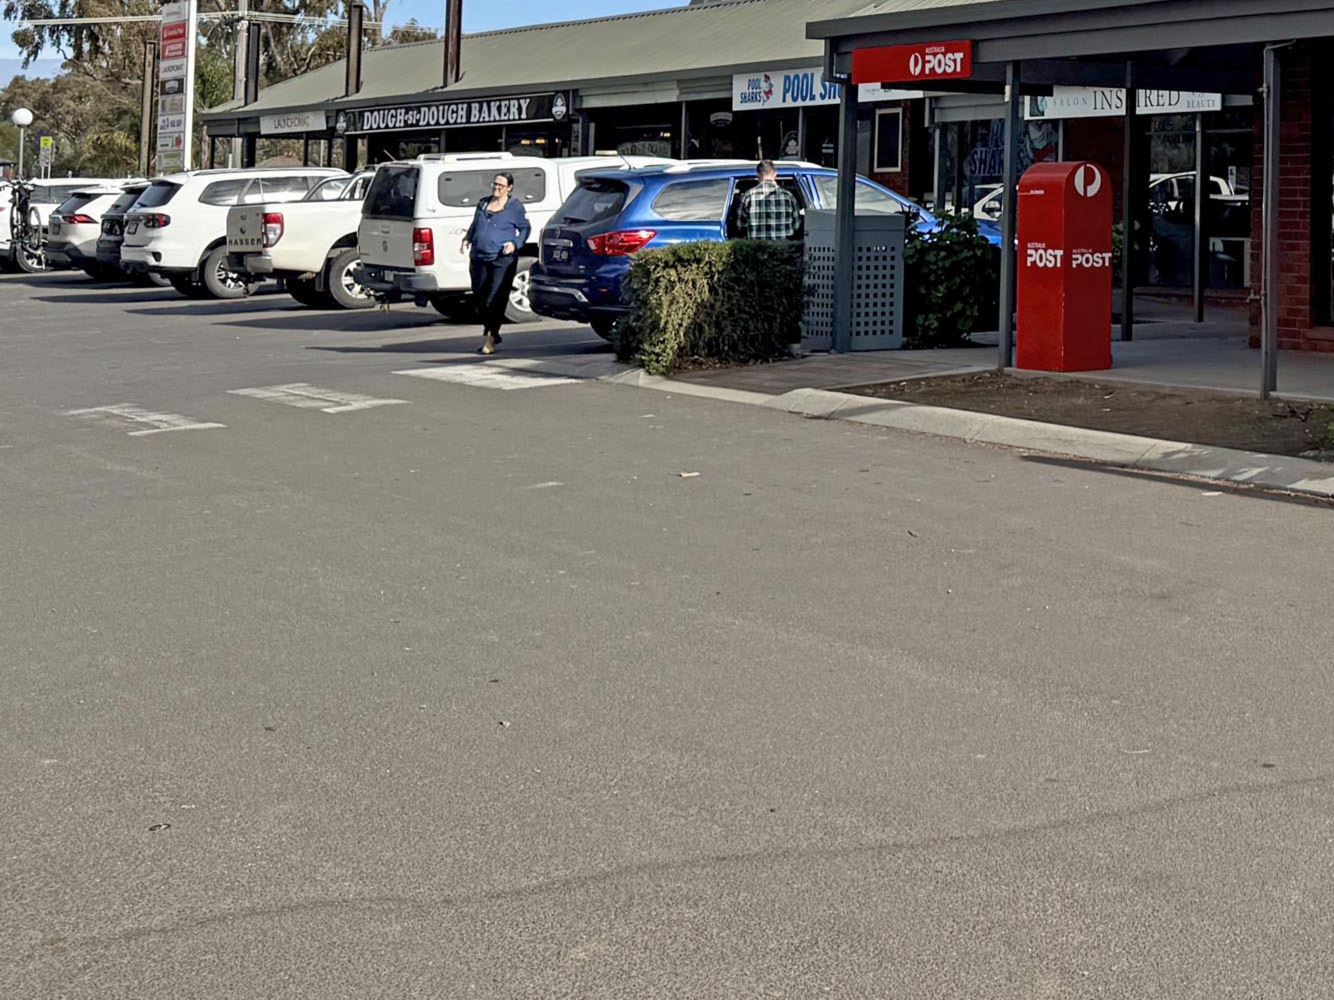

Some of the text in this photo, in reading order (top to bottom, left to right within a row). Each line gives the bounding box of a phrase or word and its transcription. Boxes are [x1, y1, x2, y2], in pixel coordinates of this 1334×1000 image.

[925, 52, 964, 75] POST
[782, 72, 816, 103] POOL
[470, 98, 530, 123] BAKERY
[1093, 88, 1181, 111] INSIRED
[969, 147, 1026, 177] SHARS
[1027, 248, 1064, 268] POST
[1072, 252, 1113, 268] POST
